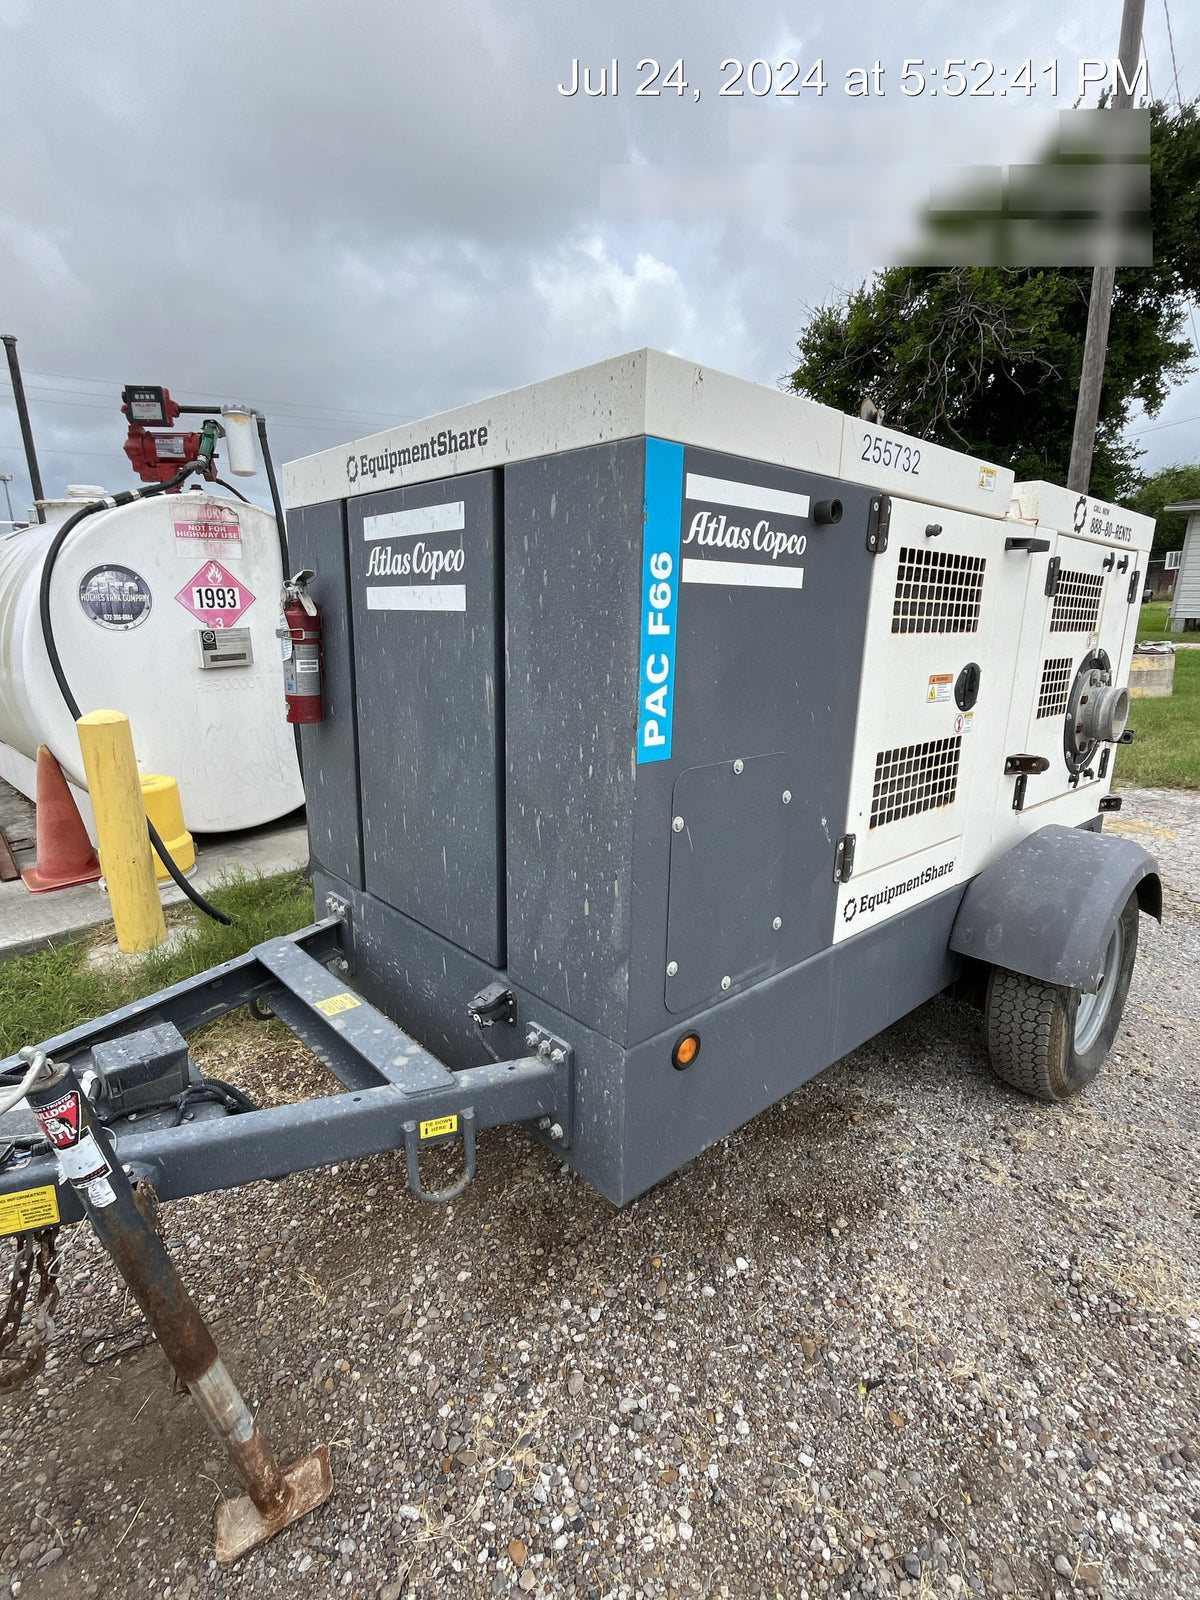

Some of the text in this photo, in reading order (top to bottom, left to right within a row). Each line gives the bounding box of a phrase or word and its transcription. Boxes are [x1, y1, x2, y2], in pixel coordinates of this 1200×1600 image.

[360, 426, 488, 478] EquipmentShare
[861, 433, 921, 475] 255732
[176, 530, 219, 538] HIGHWAY
[188, 524, 227, 533] NOT FOR
[1090, 517, 1132, 542] 888-80-RENTS
[196, 588, 237, 608] 1993
[215, 617, 224, 628] 3
[644, 551, 674, 748] PAC F66
[859, 860, 954, 914] EquipmentShare
[36, 1100, 76, 1121] ULLDOG
[435, 1118, 453, 1126] DOWN
